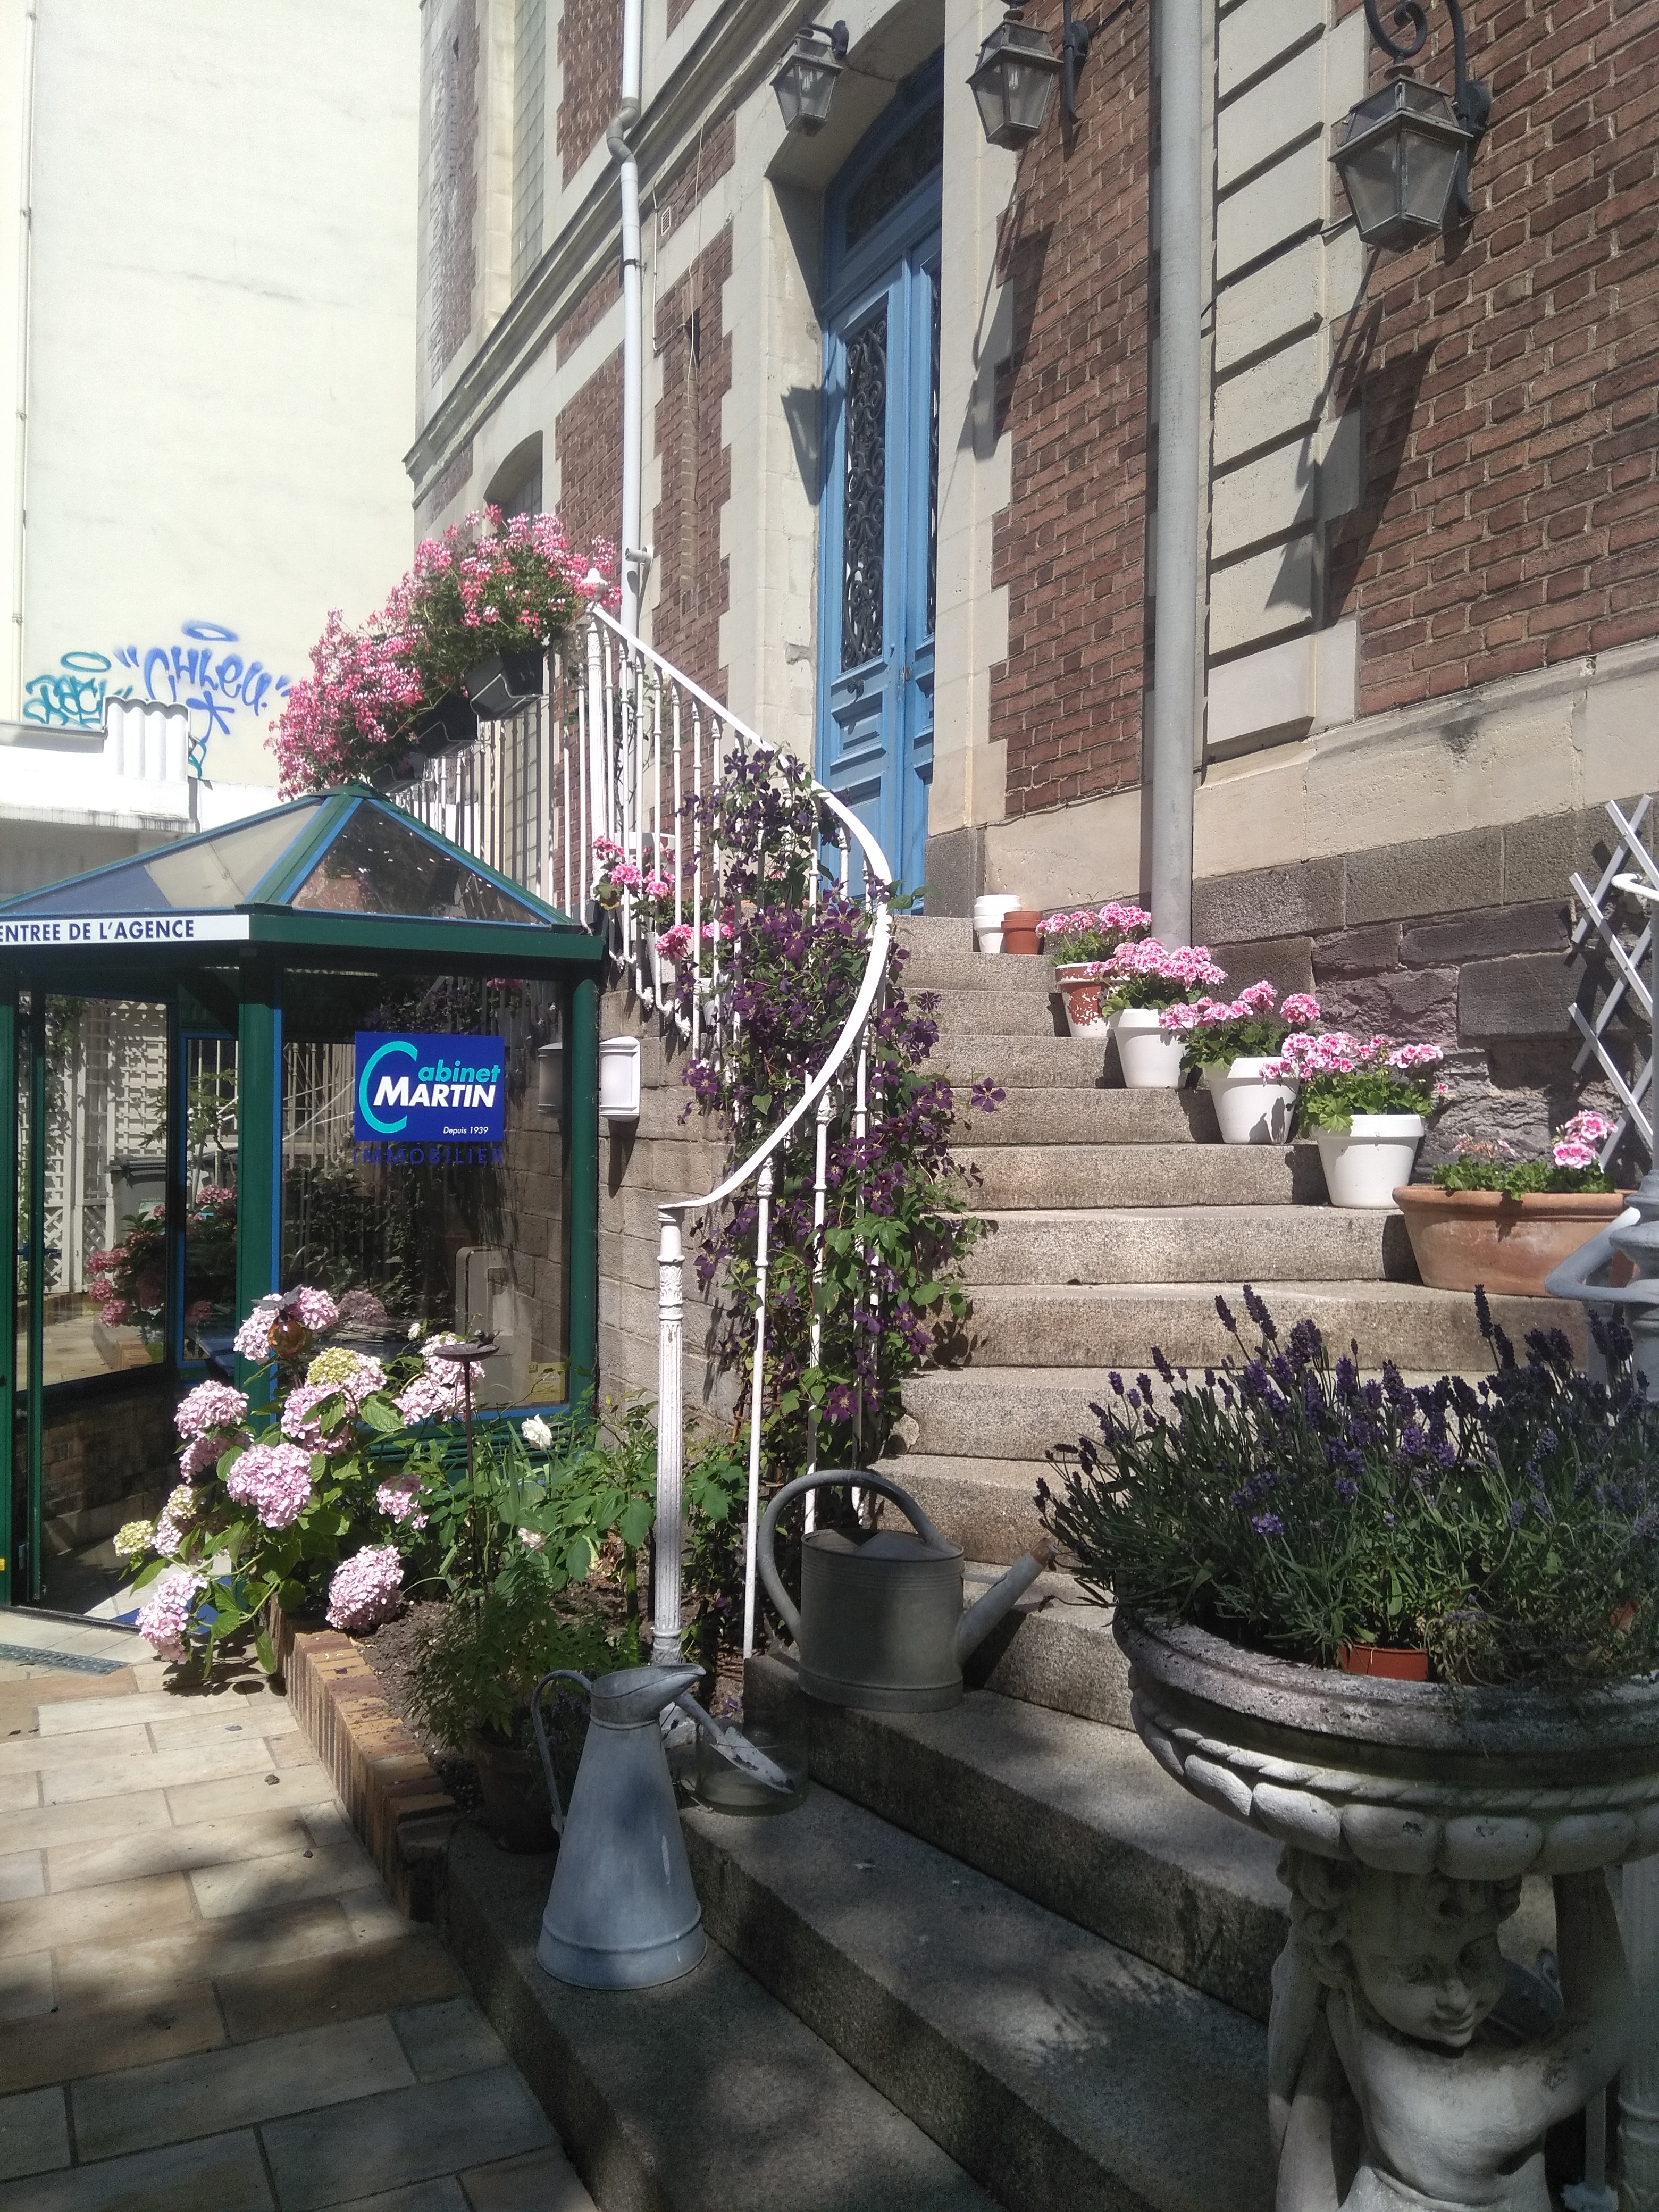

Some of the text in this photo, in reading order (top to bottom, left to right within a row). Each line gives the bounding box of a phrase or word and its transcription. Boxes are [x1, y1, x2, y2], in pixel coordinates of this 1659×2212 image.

[69, 923, 91, 940] DE
[99, 919, 195, 940] L'AGENCE
[359, 1041, 500, 1134] Cabinet
[373, 1076, 496, 1108] MARTIN
[443, 1126, 467, 1136] Depuis
[352, 1148, 502, 1164] IMMOBILIER
